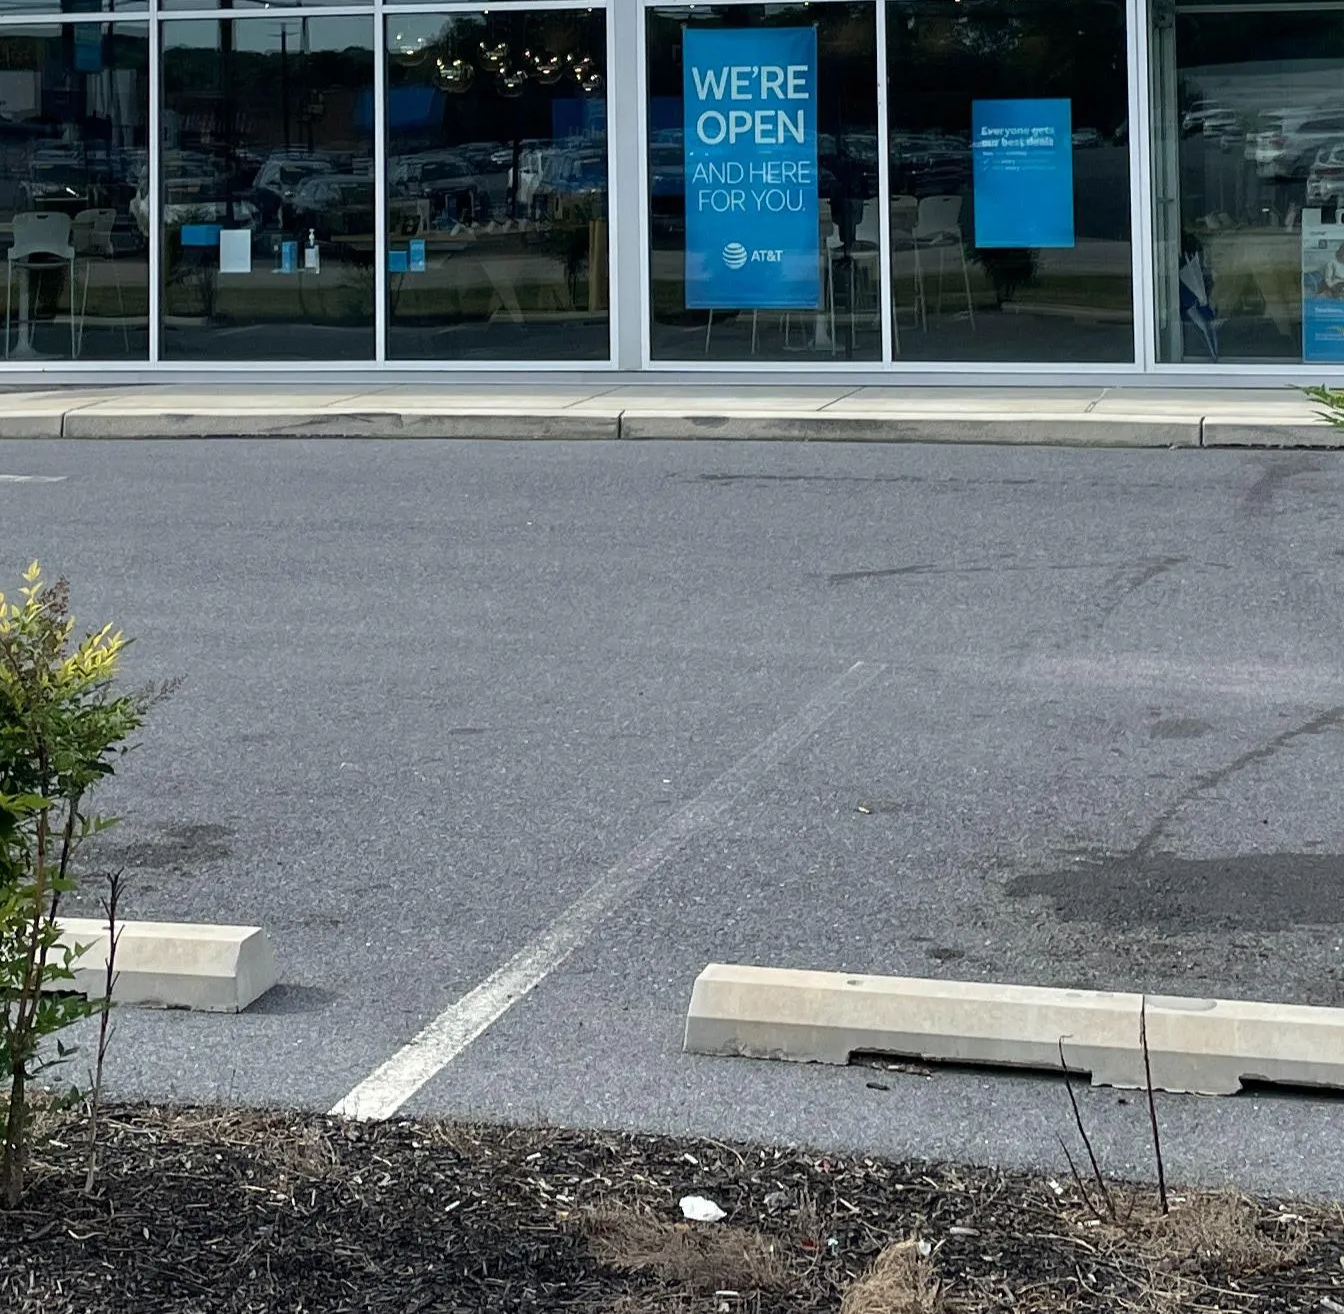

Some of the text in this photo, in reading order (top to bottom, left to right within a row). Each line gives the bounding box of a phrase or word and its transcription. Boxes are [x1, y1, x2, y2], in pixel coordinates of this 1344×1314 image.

[692, 65, 809, 100] WE'RE
[697, 110, 804, 145] OPEN
[981, 126, 1029, 137] Everyone
[692, 161, 810, 184] AND HERE
[698, 189, 805, 212] FOR YOU.
[751, 250, 783, 262] AT&T
